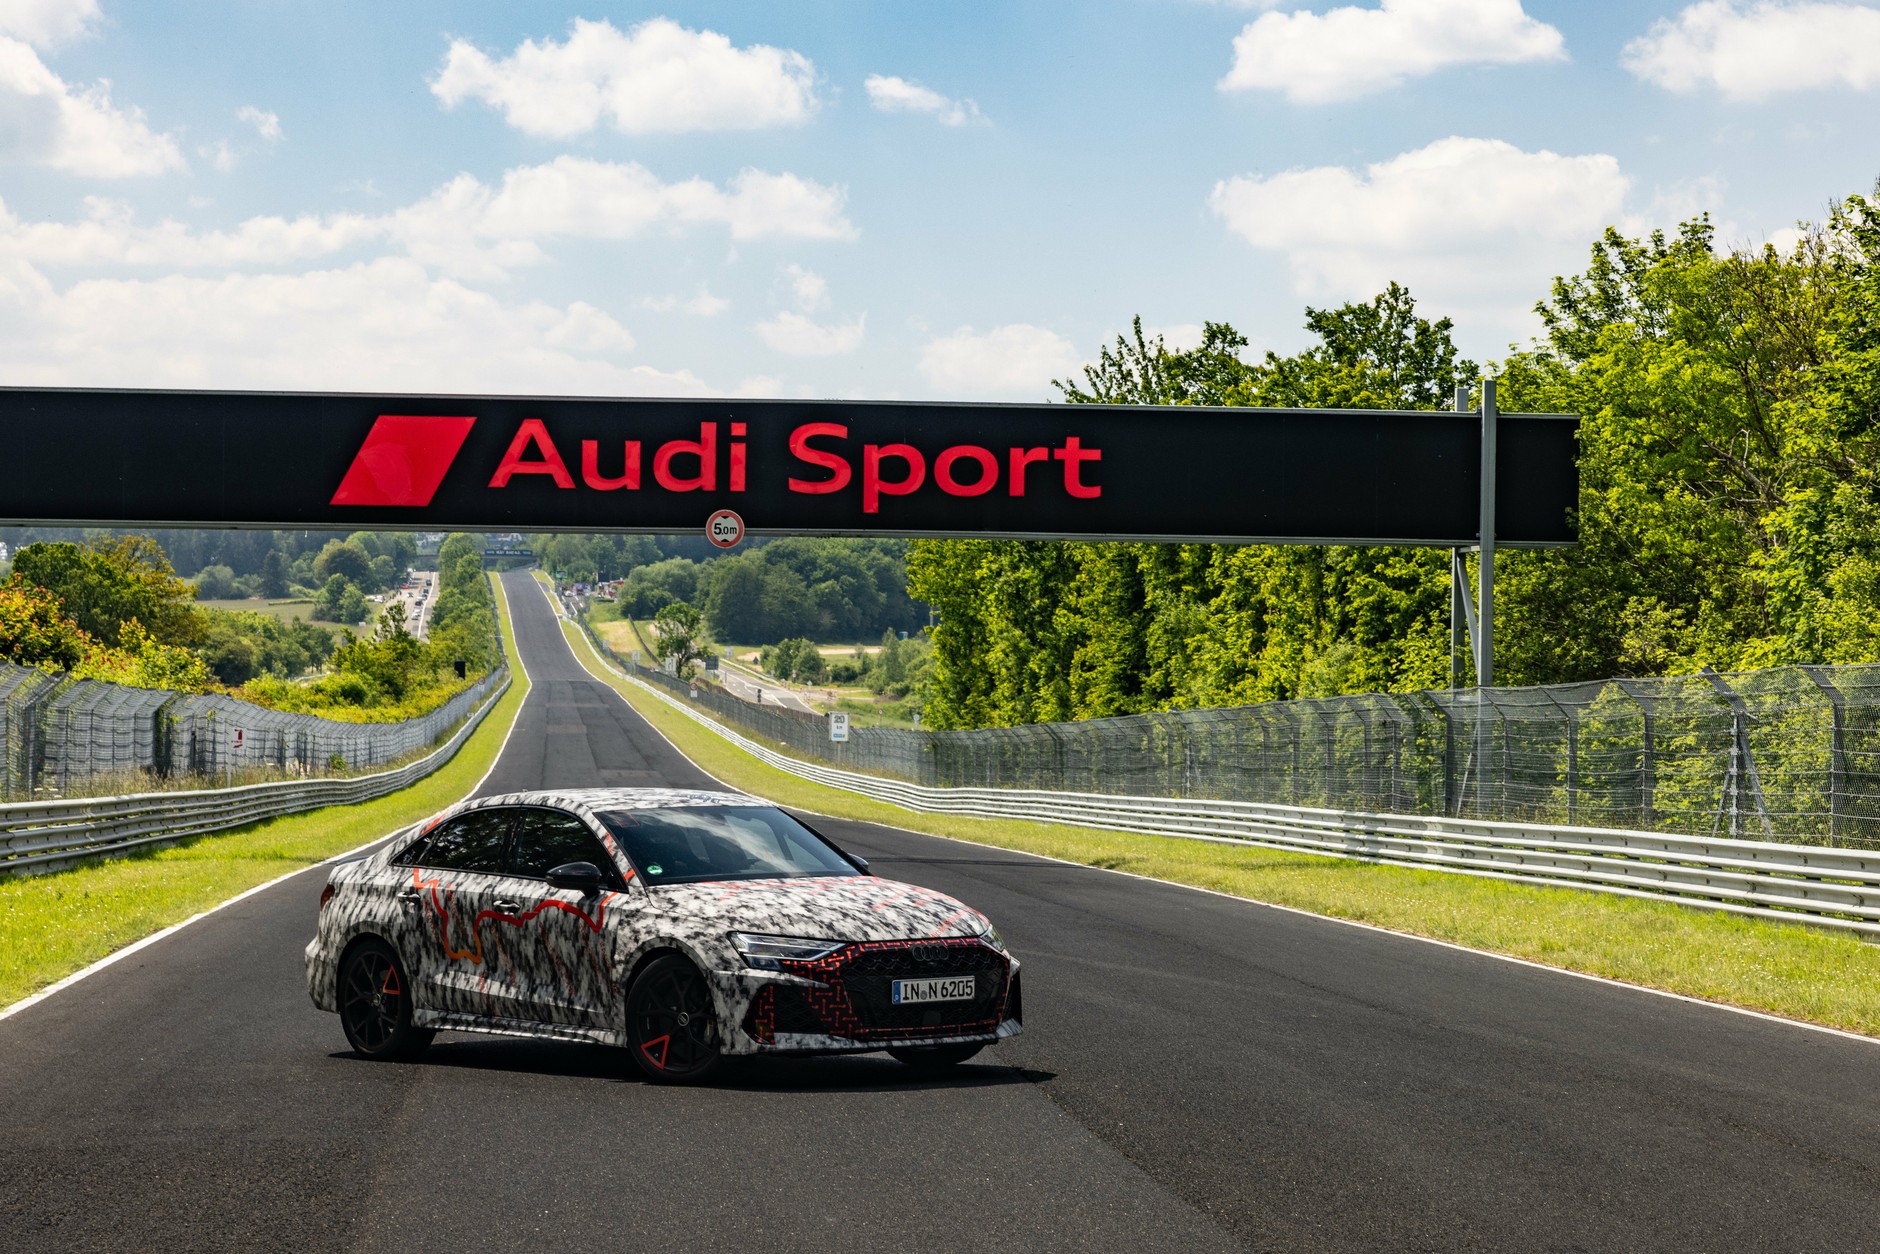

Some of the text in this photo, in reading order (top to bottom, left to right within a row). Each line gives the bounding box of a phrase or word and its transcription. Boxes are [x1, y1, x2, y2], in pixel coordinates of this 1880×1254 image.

[488, 418, 1102, 513] Audi Sport
[903, 983, 919, 1000] IN
[929, 982, 937, 999] N
[941, 980, 973, 998] 6205
